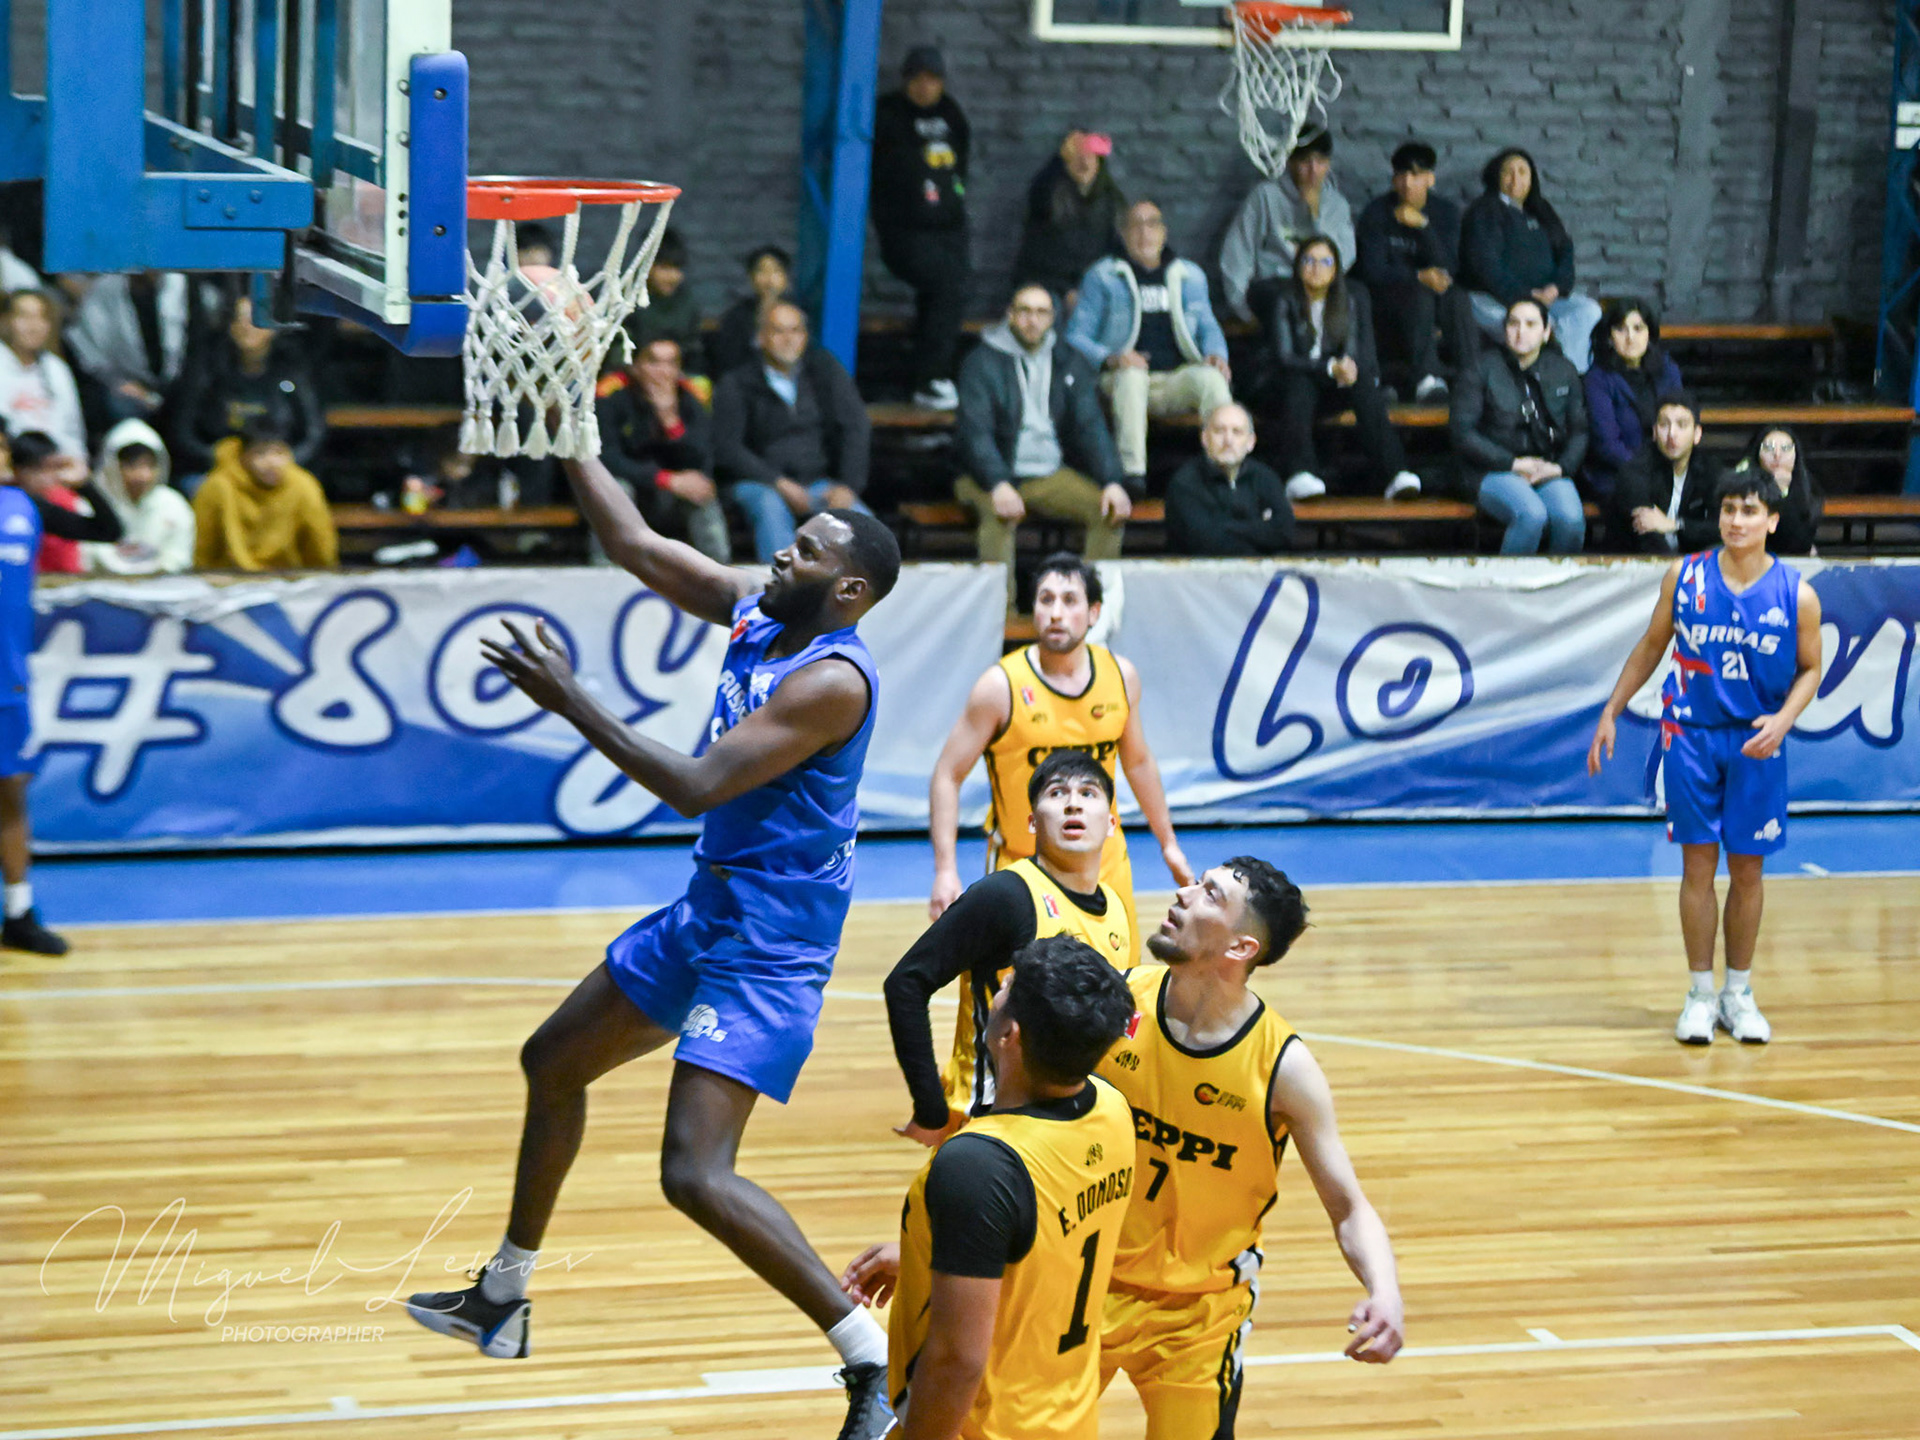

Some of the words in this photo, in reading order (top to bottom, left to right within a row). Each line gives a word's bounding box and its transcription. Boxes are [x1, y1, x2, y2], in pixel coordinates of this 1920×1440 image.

[1212, 569, 1475, 782] lo
[1721, 651, 1749, 681] 21
[1145, 1157, 1170, 1202] 7
[1058, 1207, 1077, 1238] E.
[1057, 1229, 1101, 1355] 1
